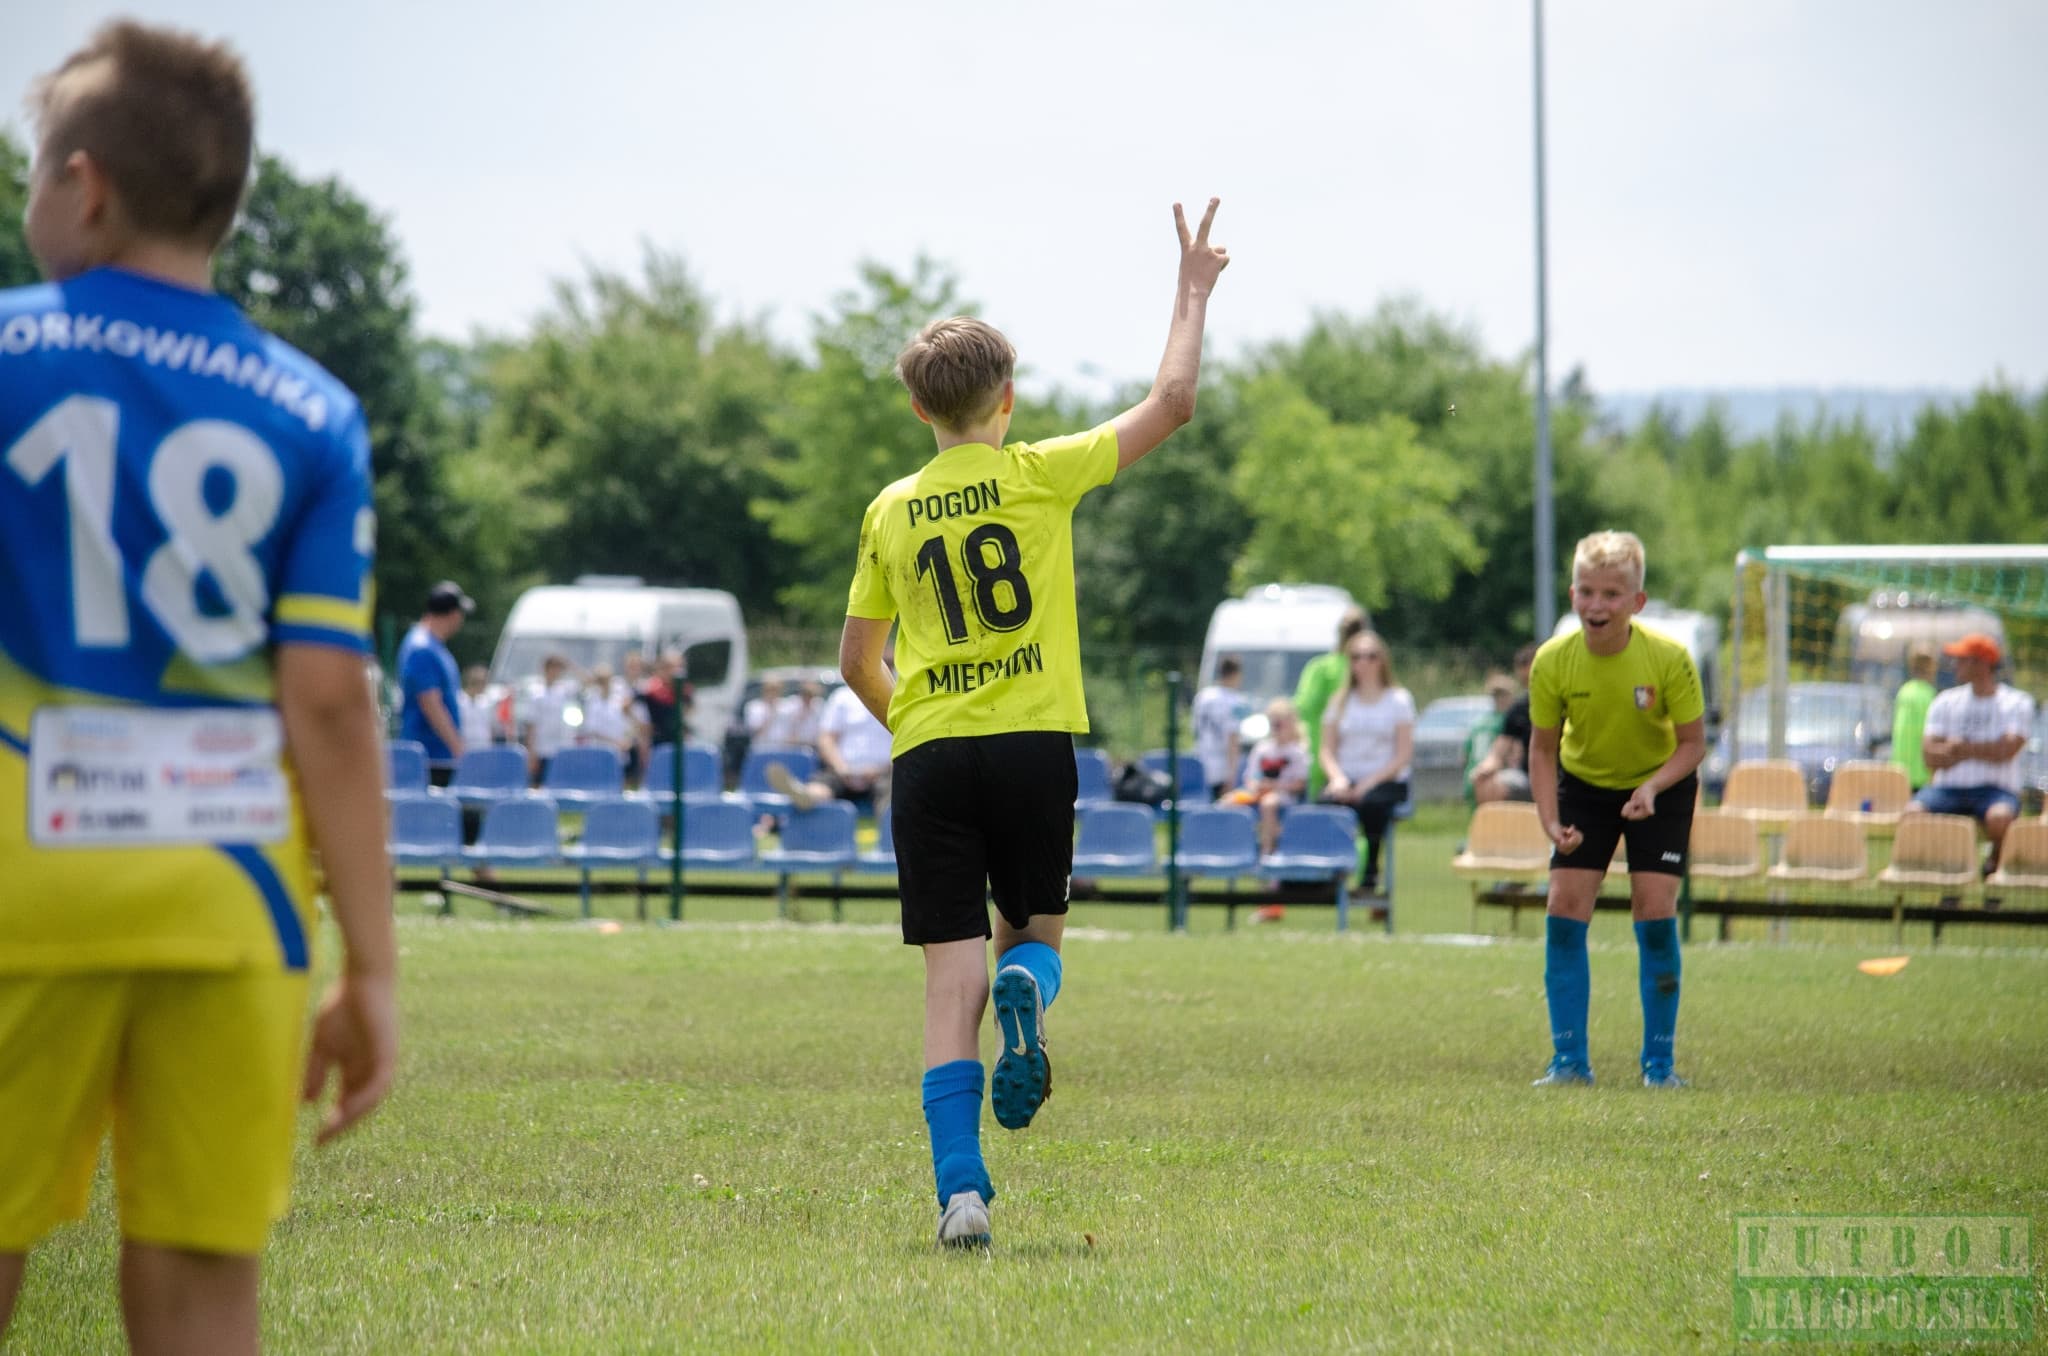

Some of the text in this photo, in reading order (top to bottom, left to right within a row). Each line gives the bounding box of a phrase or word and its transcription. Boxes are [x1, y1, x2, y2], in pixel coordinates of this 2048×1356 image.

[0, 311, 328, 433] ORKOWIANKA
[6, 393, 285, 663] 18
[914, 523, 1033, 645] 18
